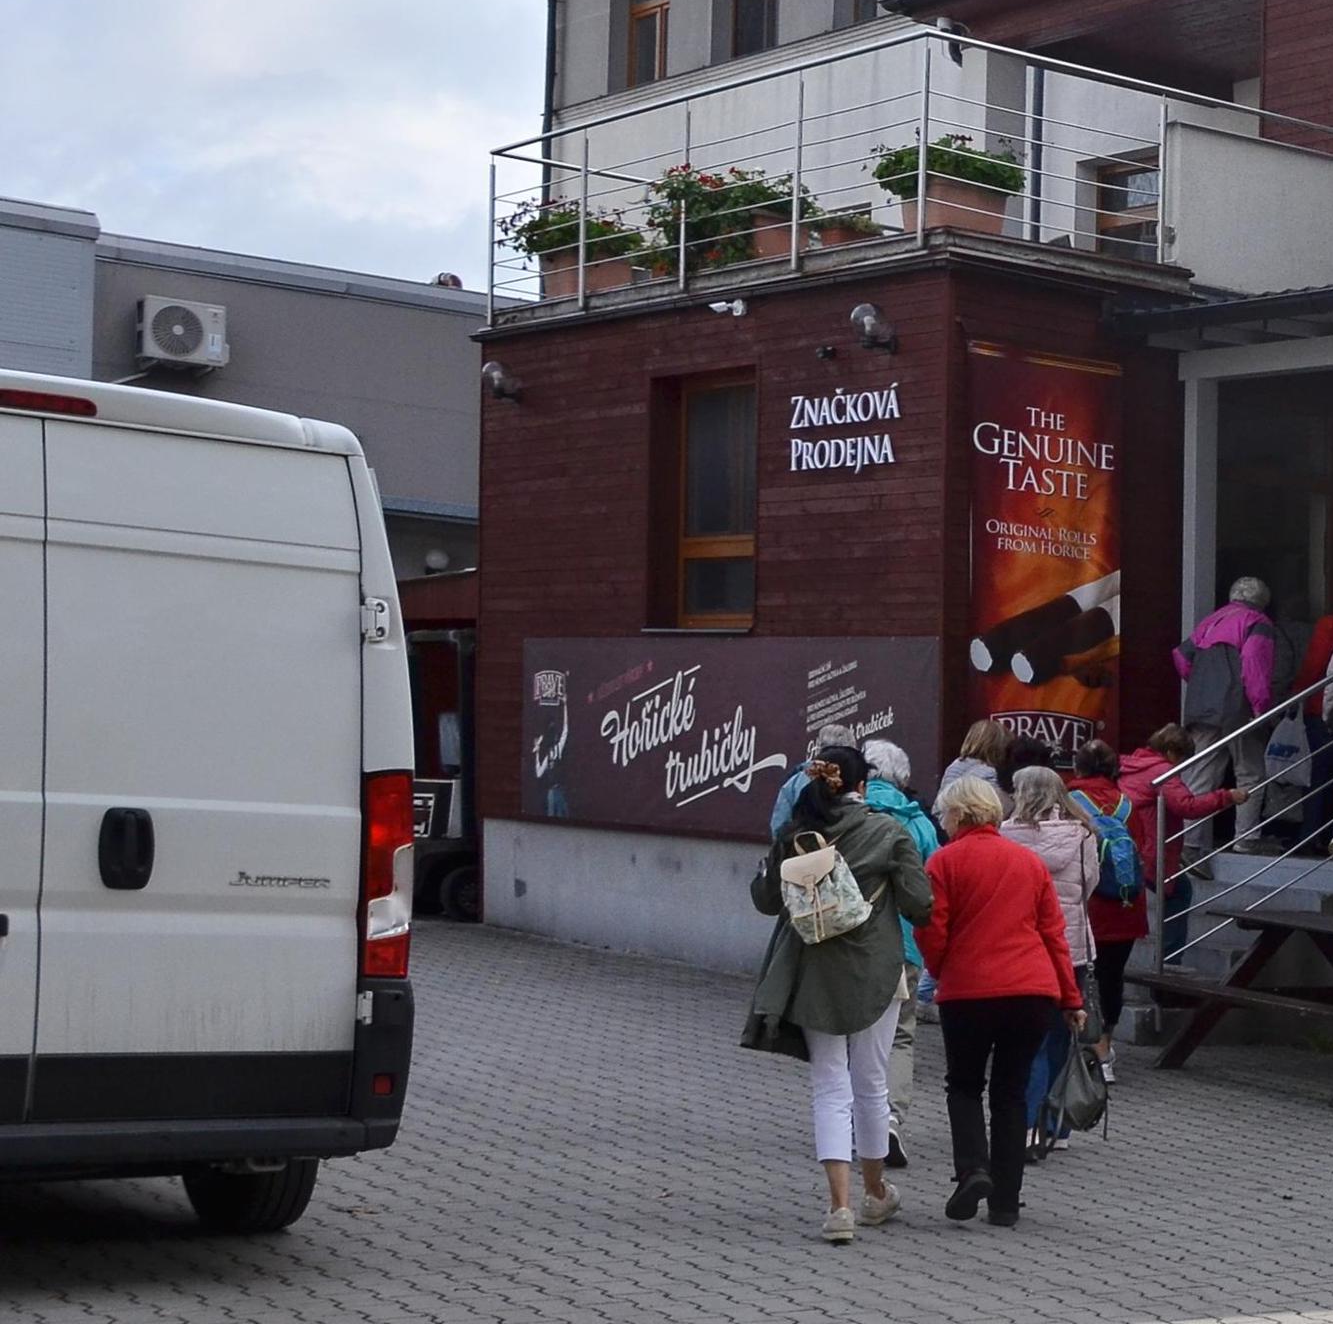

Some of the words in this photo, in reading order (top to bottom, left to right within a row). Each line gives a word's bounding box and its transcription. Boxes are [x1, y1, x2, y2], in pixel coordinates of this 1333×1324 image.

[789, 381, 901, 429] ZNAČKOVÁ
[1026, 406, 1066, 432] THE
[789, 433, 896, 474] PRODEJNA
[973, 422, 1115, 470] GENUINE
[999, 457, 1089, 501] TASTE
[985, 518, 1053, 541] ORIGINAL
[1058, 527, 1097, 546] ROLLS
[997, 537, 1037, 554] FROM
[1040, 542, 1091, 561] HORICE
[600, 671, 697, 768] Hořické
[664, 704, 789, 800] trubičky
